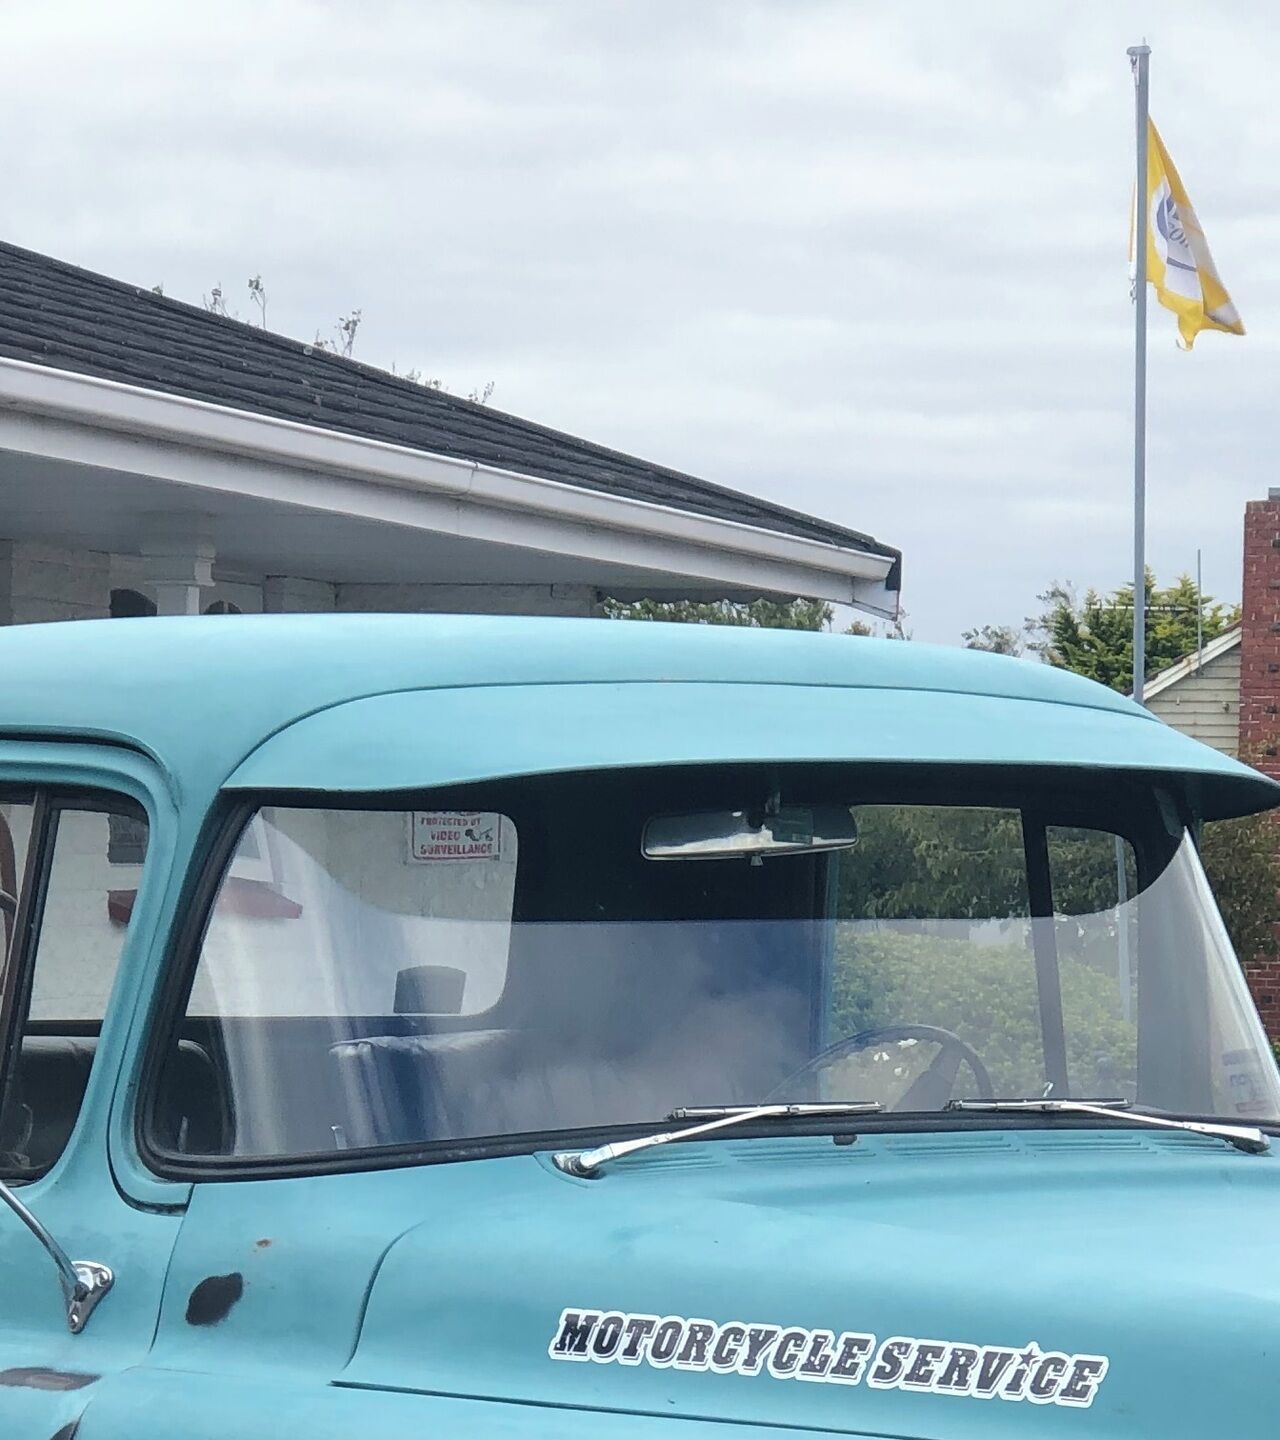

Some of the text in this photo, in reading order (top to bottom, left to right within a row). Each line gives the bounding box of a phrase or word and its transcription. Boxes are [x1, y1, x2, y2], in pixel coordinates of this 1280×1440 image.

[431, 830, 461, 841] VIDEO
[421, 843, 493, 855] SURVEILLANCE
[552, 1311, 873, 1380] MOTORCYCLE
